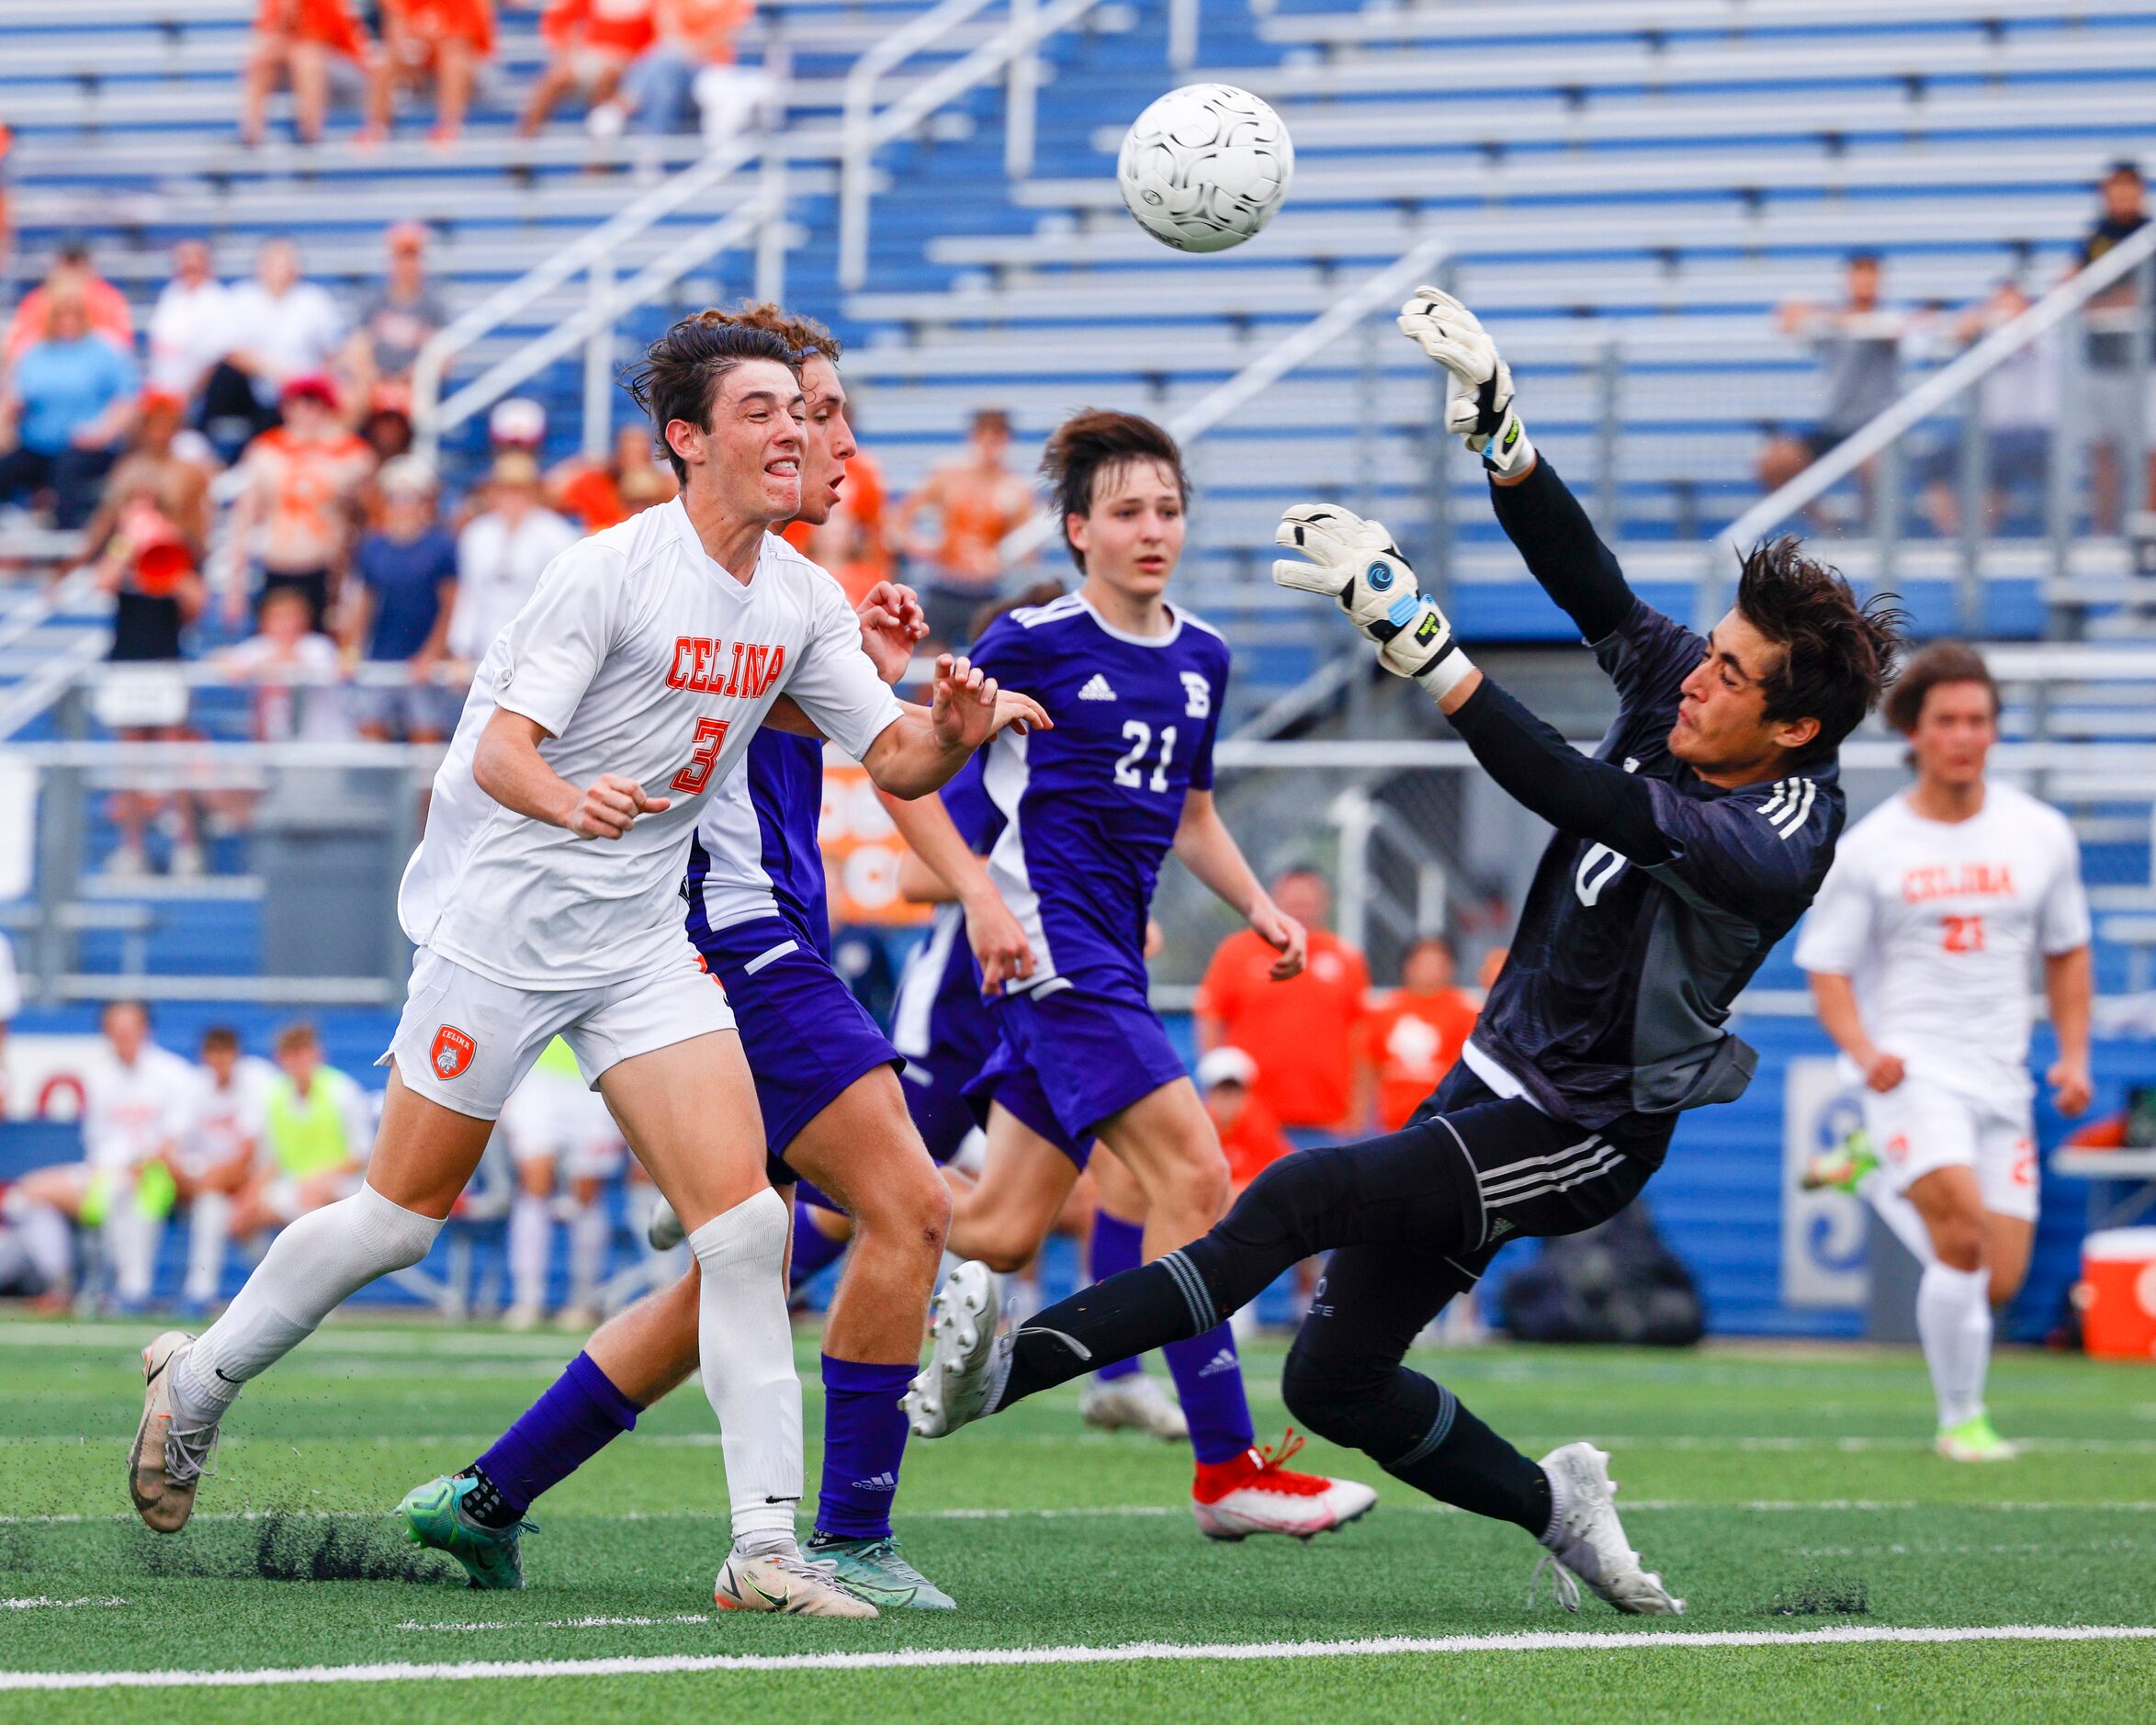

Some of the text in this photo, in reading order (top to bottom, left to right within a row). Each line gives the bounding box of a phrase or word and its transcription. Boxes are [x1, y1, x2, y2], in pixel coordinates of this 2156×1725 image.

[665, 636, 785, 699] CELINA
[670, 716, 730, 796] 3
[1112, 719, 1177, 794] 21
[442, 1030, 470, 1050] CELINA
